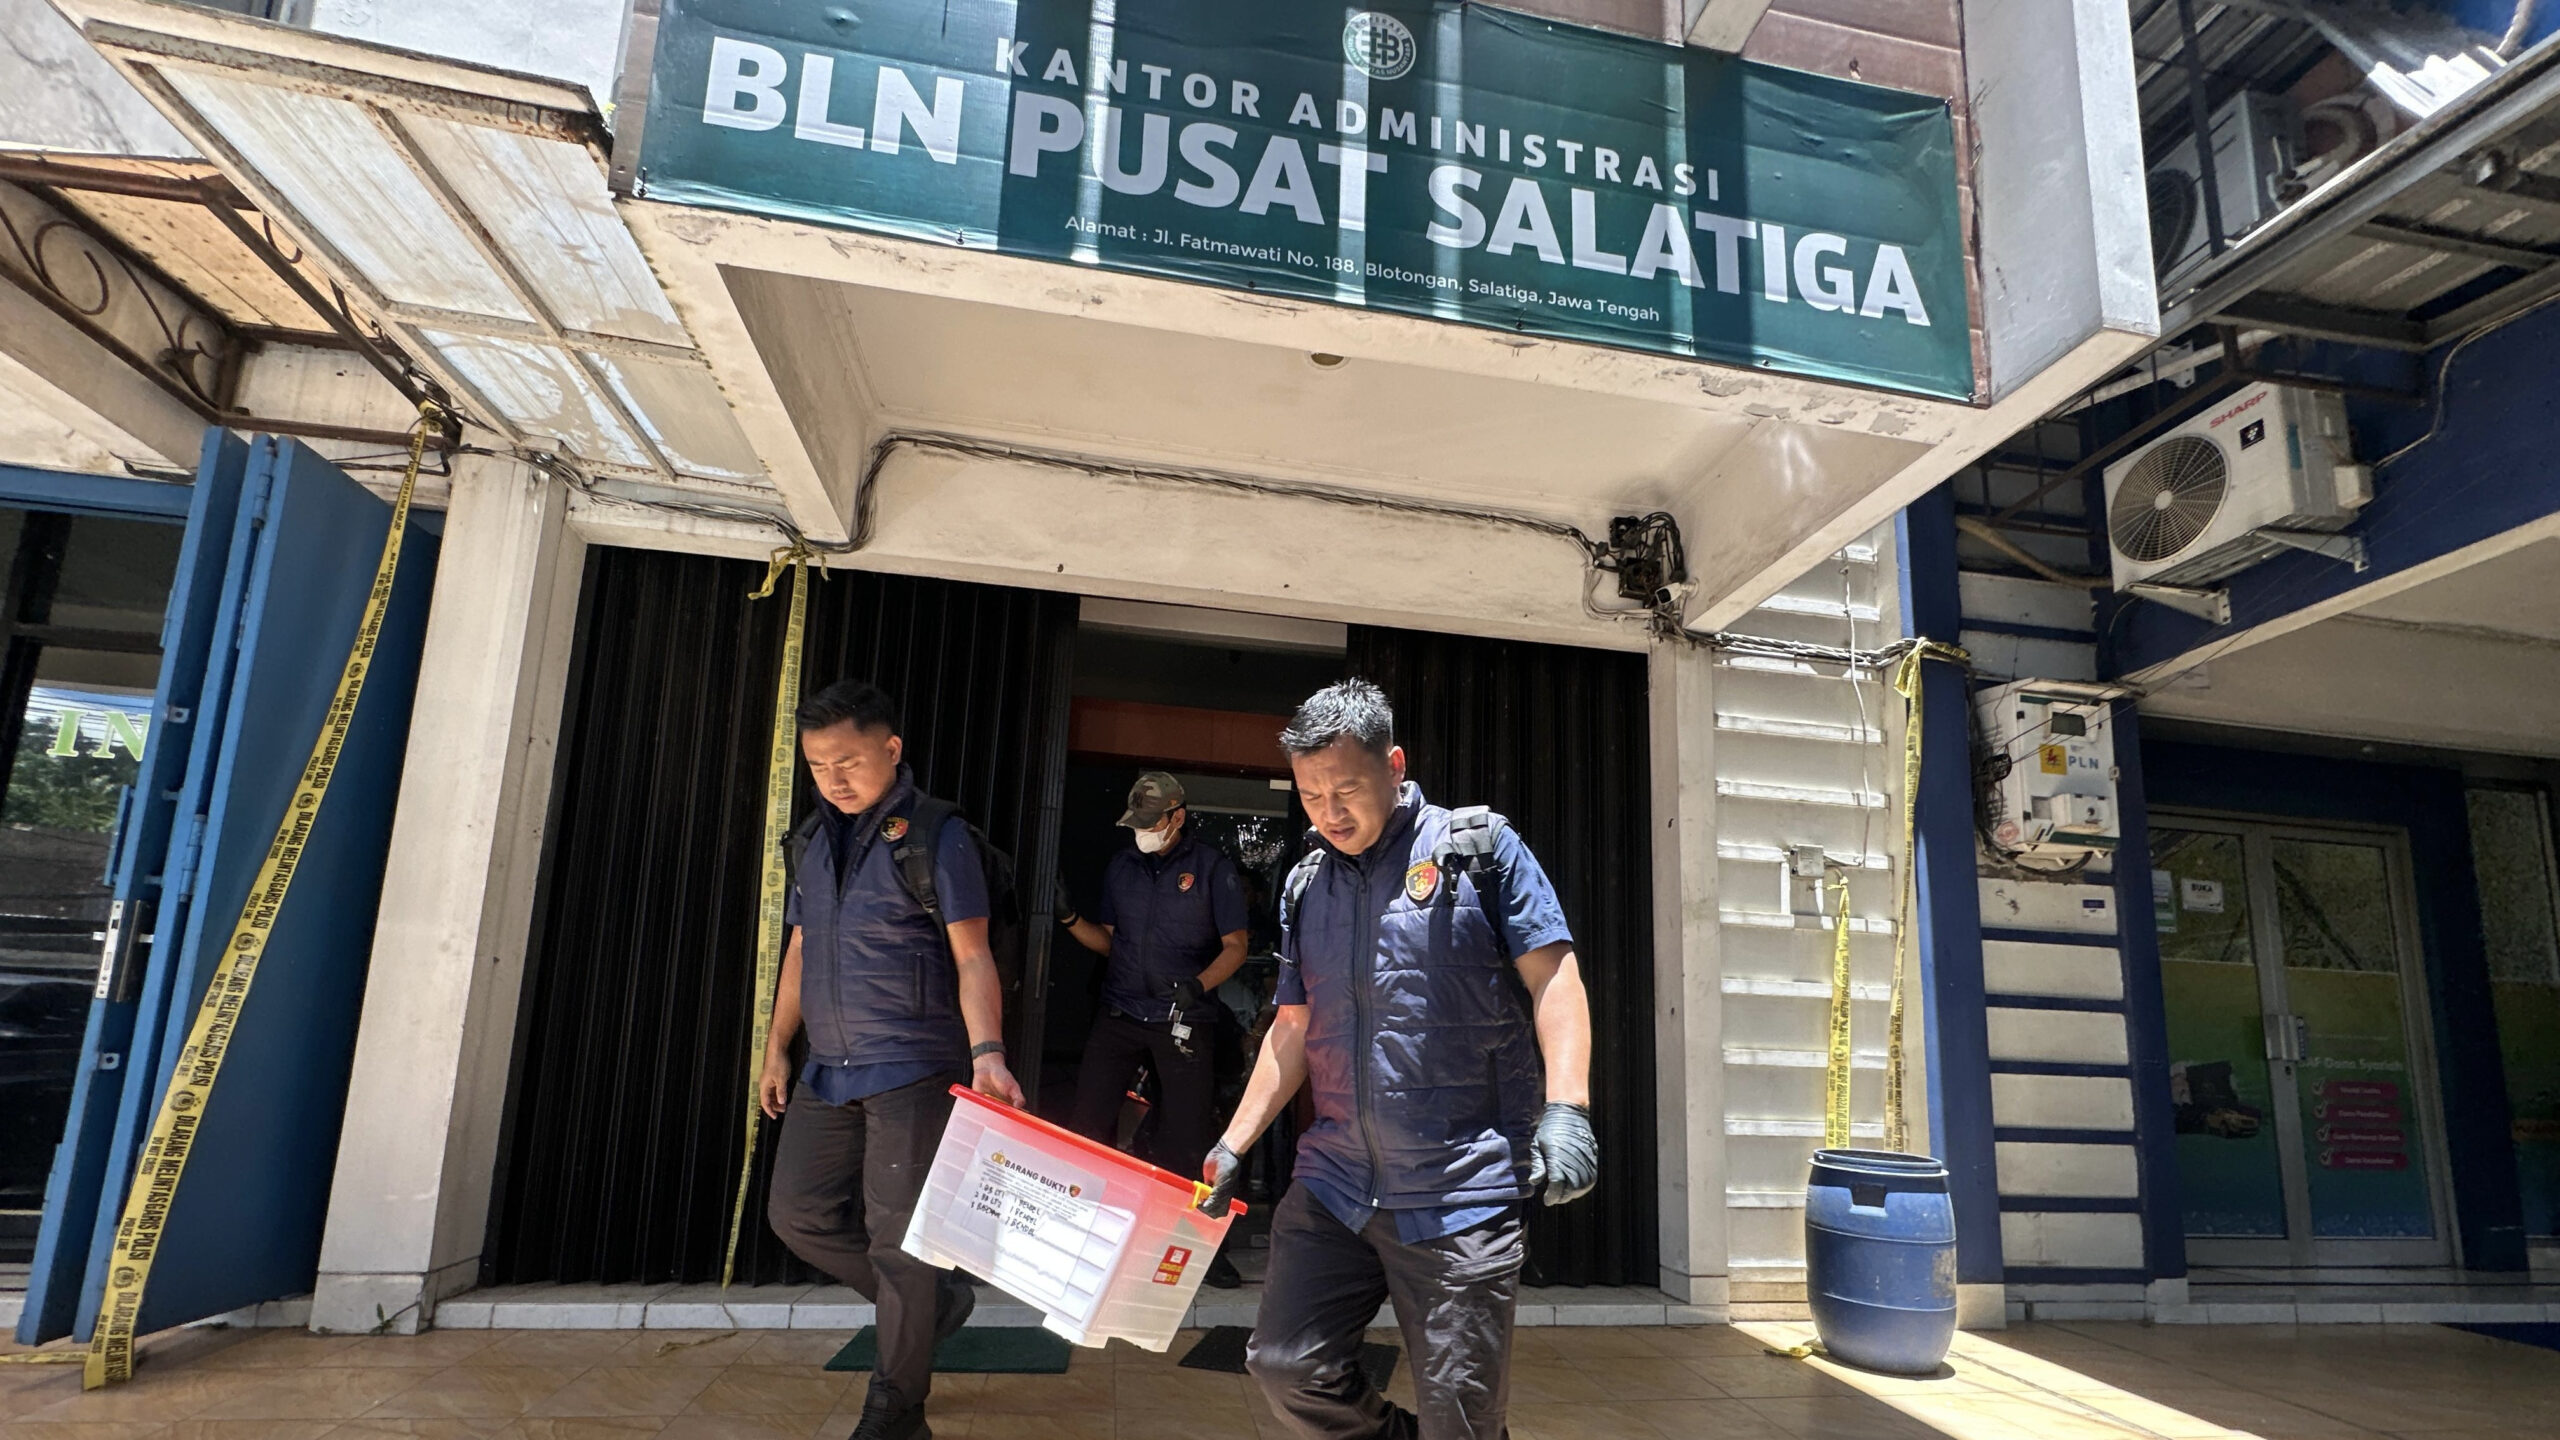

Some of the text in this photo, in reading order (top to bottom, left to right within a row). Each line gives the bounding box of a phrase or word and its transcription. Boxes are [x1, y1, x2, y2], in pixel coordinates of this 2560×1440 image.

[994, 37, 1719, 201] KANTOR ADMINISTRASI
[702, 35, 1931, 327] BLN PUSAT SALATIGA
[1064, 215, 1136, 240] Alamat
[1153, 229, 1174, 246] Jl.
[1180, 233, 1281, 262] Fatmawati
[1287, 250, 1319, 269] No.
[1324, 255, 1360, 276] 188,
[1365, 261, 1463, 293] Blotongan,
[1468, 279, 1543, 305] Salatiga,
[1548, 291, 1592, 312] Jawa
[1597, 298, 1660, 323] Tengah
[2209, 391, 2268, 429] SHARP
[2068, 756, 2099, 770] PLN
[1004, 1160, 1039, 1180] BARANG
[1039, 1175, 1067, 1194] BUKTI
[128, 1232, 157, 1260] POLISI
